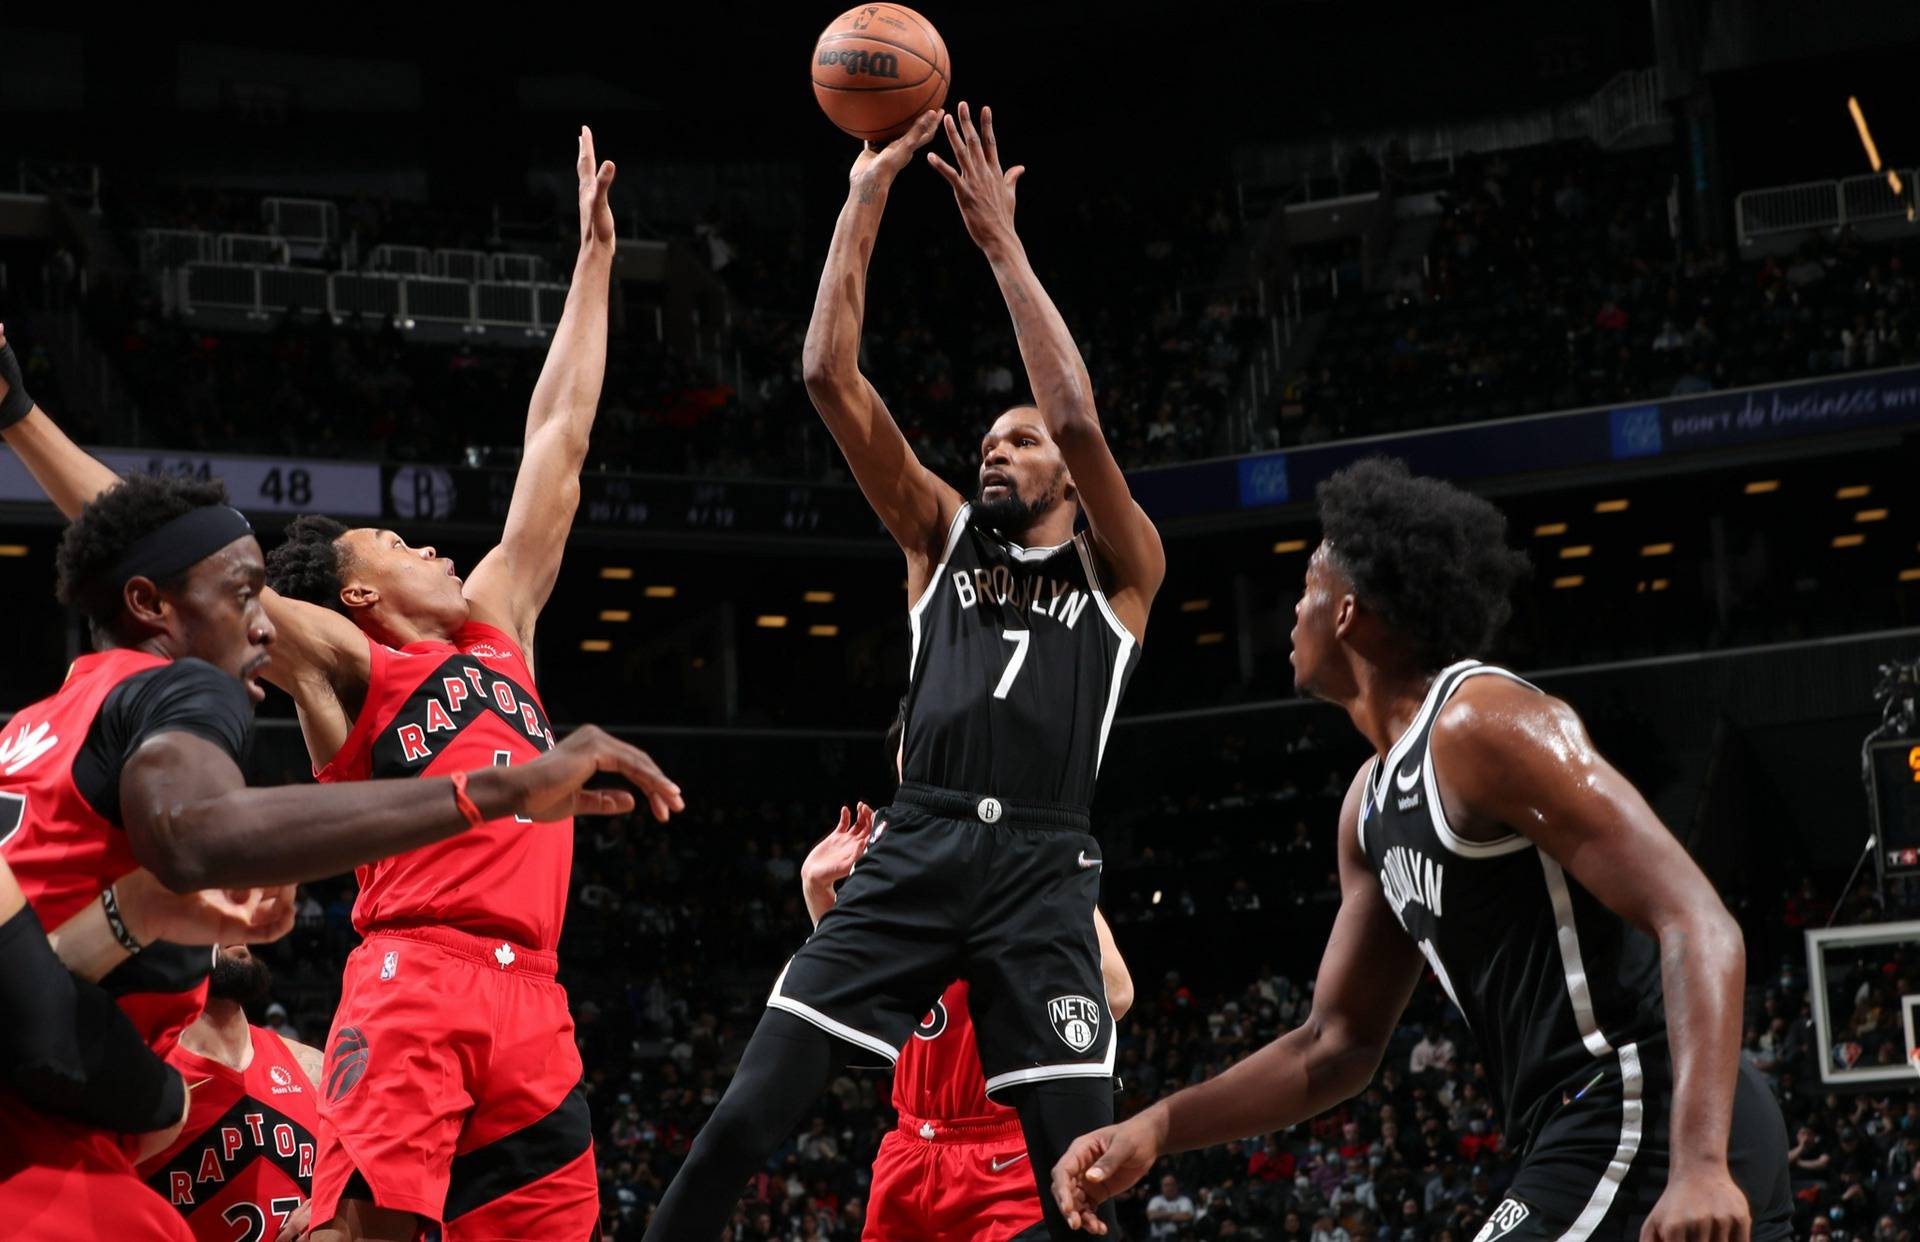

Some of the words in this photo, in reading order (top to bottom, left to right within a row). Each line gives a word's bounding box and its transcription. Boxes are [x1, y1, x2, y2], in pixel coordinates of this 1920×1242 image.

[818, 49, 898, 80] Wilson
[1881, 385, 1920, 411] WIT
[259, 466, 312, 507] 48
[993, 629, 1030, 699] 7
[1052, 998, 1098, 1025] NETS
